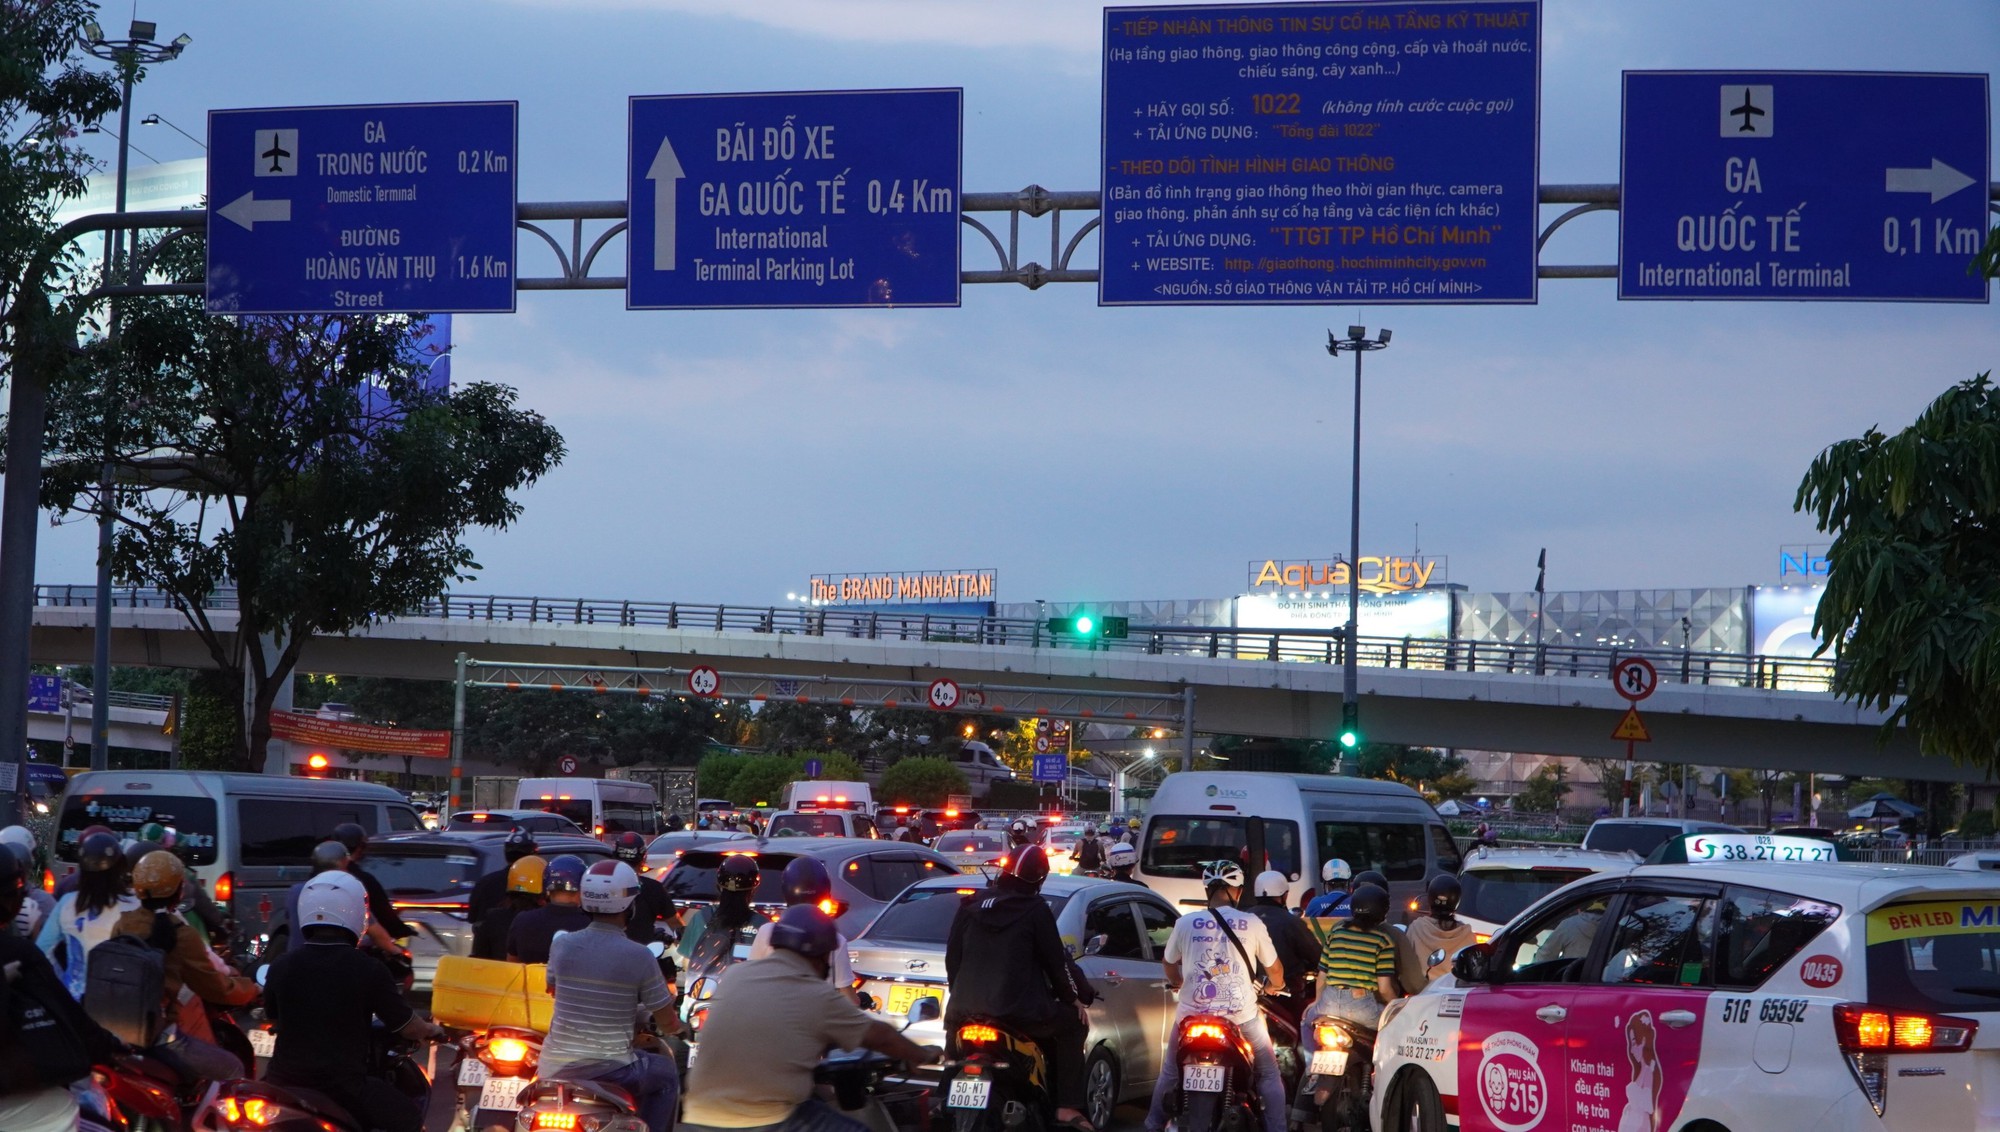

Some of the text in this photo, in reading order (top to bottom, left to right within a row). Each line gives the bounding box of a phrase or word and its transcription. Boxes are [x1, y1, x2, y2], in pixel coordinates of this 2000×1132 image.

[1239, 63, 1346, 79] chiếu cây
[1148, 93, 1514, 119] HÃY GỌI SỐ: 1022 (không tính cước cuộc gọi)
[364, 121, 386, 144] GA
[717, 115, 835, 162] BÃI ĐỖ XE
[1148, 123, 1339, 142] TẢI ỨNG DỤNG: đài
[317, 146, 508, 176] TRONG NƯỚC 0,2 Km
[1121, 154, 1395, 175] THEO DÕI TÌNH HÌNH GIAO THÔNG
[1725, 156, 1762, 194] GA
[327, 184, 416, 204] Domestic Terminal
[700, 167, 952, 216] GA QUỐC TẾ 0,4 Km
[1109, 182, 1503, 201] (Bản tình trạng giao thông theo thời gian camera
[1115, 203, 1500, 223] giao phản ánh tầng các tiện ích khác)
[341, 225, 400, 247] ĐƯỜNG
[716, 226, 828, 250] International
[1146, 224, 1435, 249] TẢI ỨNG DỤNG: TP Hồ Chí
[1677, 201, 1980, 256] QUỐC TẾ 0,1 Km
[306, 252, 508, 282] HOÀNG VĂN THỤ 1,6 Km
[694, 257, 855, 287] Terminal Parking Lot
[1146, 257, 1214, 271] WEBSITE:
[1639, 262, 1851, 288] International Terminal
[1214, 277, 1435, 296] SỞ THÔNG VẬN TP. HỒ CHÍ
[334, 290, 384, 307] Street
[811, 574, 992, 601] The GRAND MANHATTAN
[1784, 846, 1804, 861] 27
[1811, 848, 1833, 862] 27
[1888, 911, 1923, 931] ĐÈN
[1924, 911, 1954, 927] LED
[1802, 962, 1837, 983] 10435
[1723, 998, 1809, 1024] 51G 65592
[1406, 1046, 1445, 1061] 38 27 27 27
[1190, 1067, 1218, 1079] 78-C1
[1508, 1067, 1537, 1083] PHỤ SẢN
[1570, 1059, 1615, 1078] Khám thai
[955, 1081, 984, 1095] 50-N1
[1185, 1079, 1221, 1091] 500.26
[1575, 1077, 1611, 1101] đều đặn
[950, 1095, 987, 1108] 900.57
[1509, 1081, 1540, 1115] 315
[1576, 1101, 1610, 1120] Mẹ tròn
